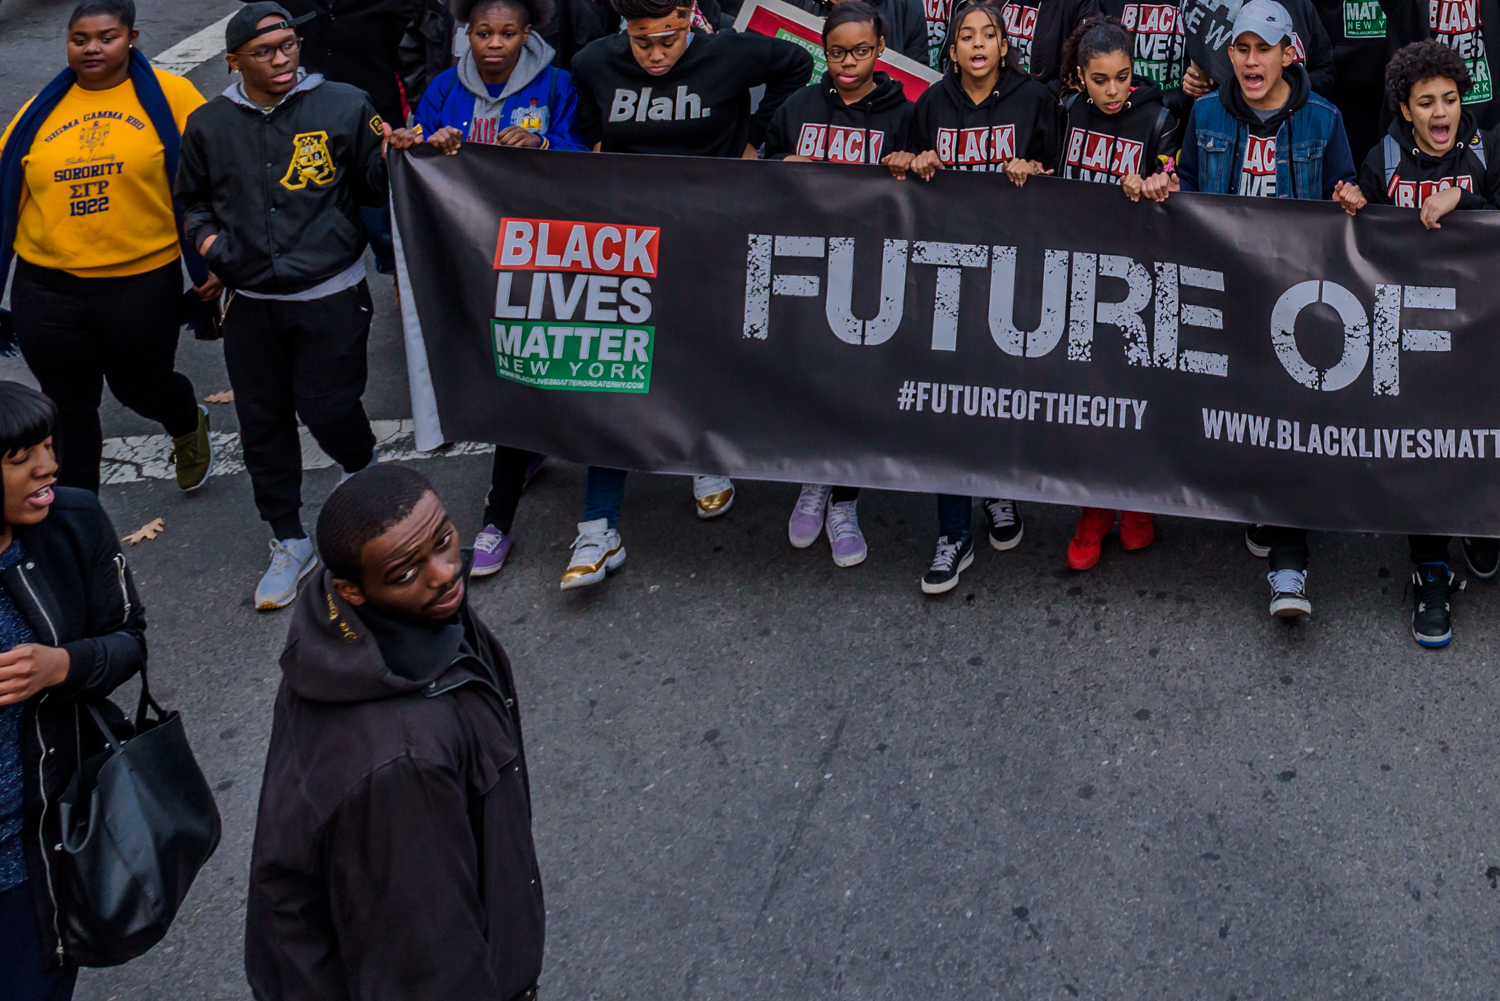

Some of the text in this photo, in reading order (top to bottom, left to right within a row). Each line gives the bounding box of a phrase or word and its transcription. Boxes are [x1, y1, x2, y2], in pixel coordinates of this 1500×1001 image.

[1346, 2, 1386, 21] MAT
[1347, 20, 1372, 30] NEW
[1135, 33, 1182, 60] IVES
[1436, 32, 1485, 60] IVES
[1133, 62, 1180, 81] ATTER
[608, 85, 712, 123] Blah.
[44, 110, 145, 143] SIGMA GAMMA RHO
[800, 123, 885, 164] BLACK
[938, 125, 1014, 165] BLACK
[1068, 129, 1142, 175] BLACK
[1243, 136, 1277, 173] LAC
[54, 162, 125, 183] SORORITY
[1239, 173, 1277, 198] IVE
[69, 196, 110, 217] 1922
[499, 220, 657, 274] BLACK
[494, 271, 652, 324] LIVES
[743, 233, 1229, 377] FUTURE
[1270, 279, 1457, 397] OF
[495, 324, 649, 363] MATTER
[498, 354, 646, 380] NEW YORK
[897, 380, 1148, 430] #FUTUREOFTHECITY
